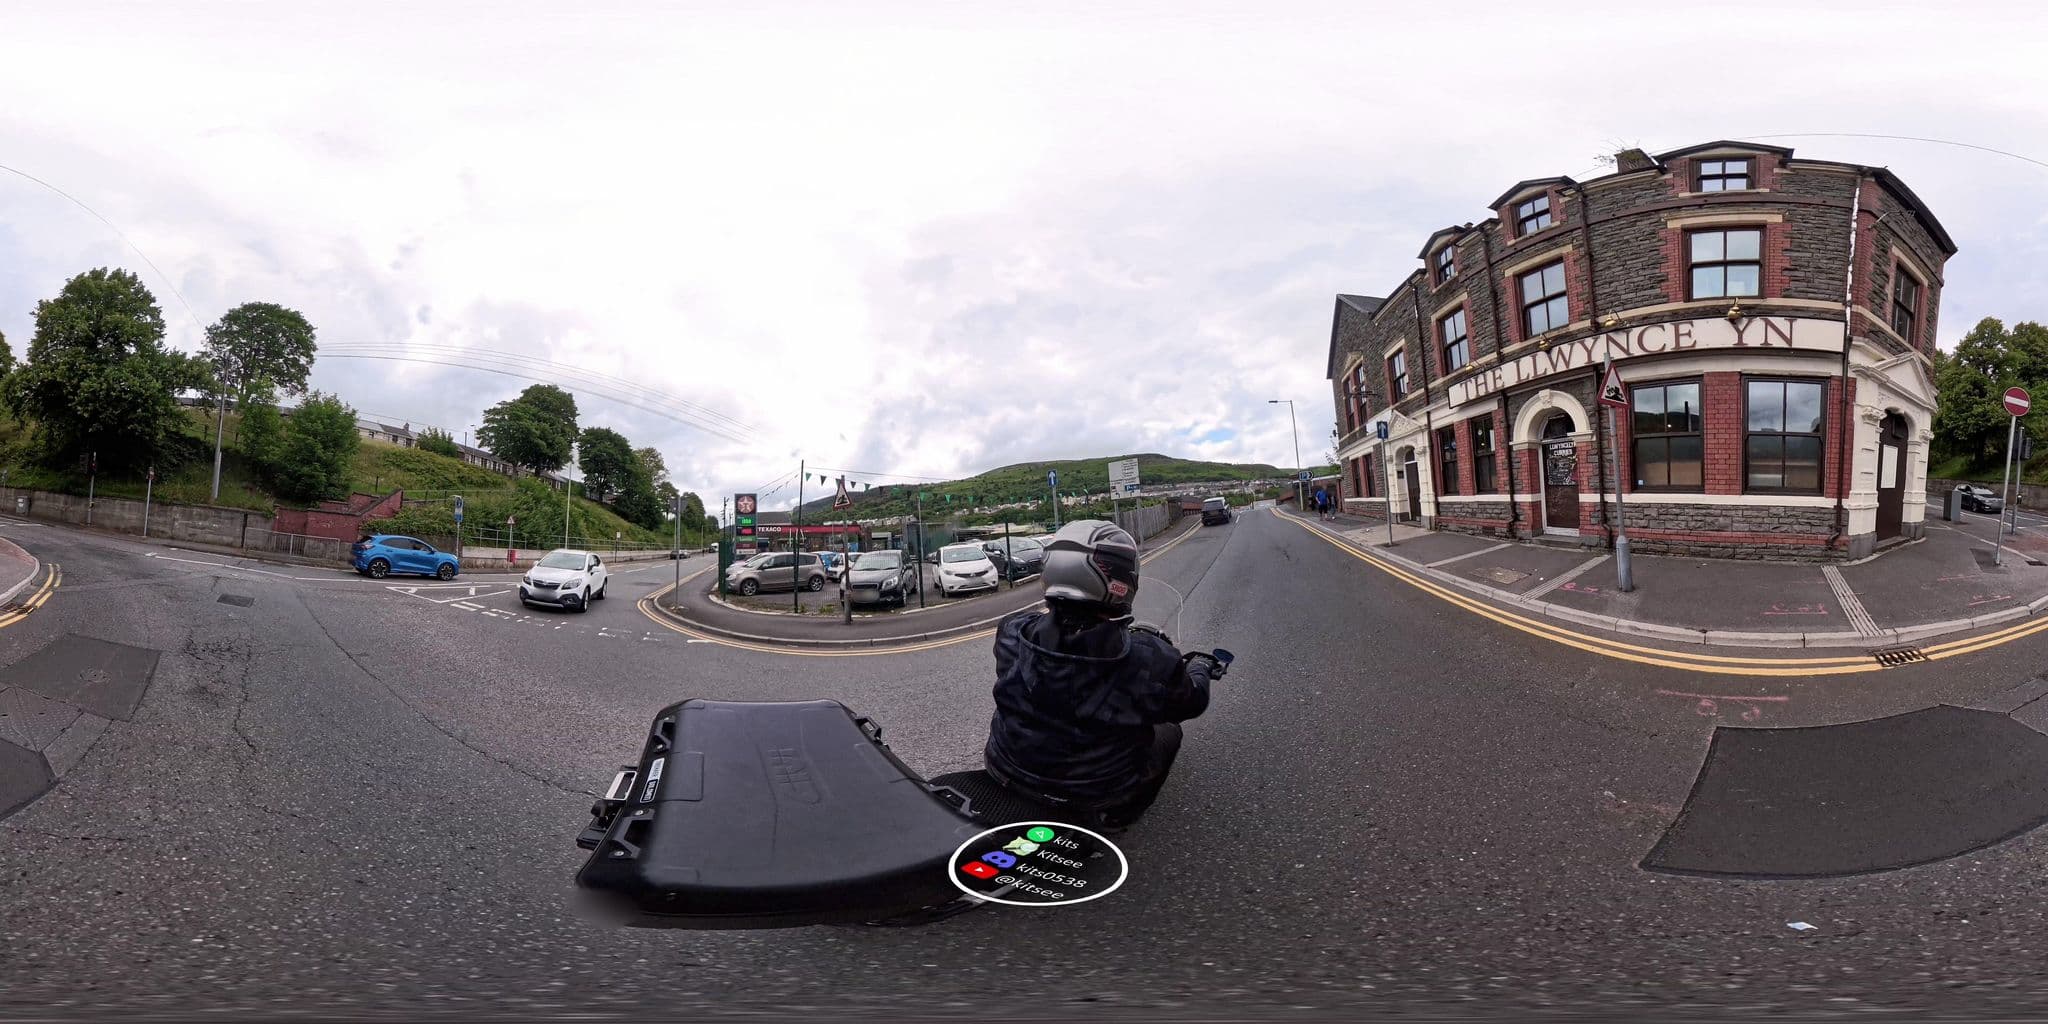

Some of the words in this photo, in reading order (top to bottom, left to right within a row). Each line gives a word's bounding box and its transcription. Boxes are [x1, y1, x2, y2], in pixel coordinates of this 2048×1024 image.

[1460, 366, 1504, 400] THE
[1515, 320, 1697, 384] LLWYNCE
[1724, 317, 1797, 347] YN
